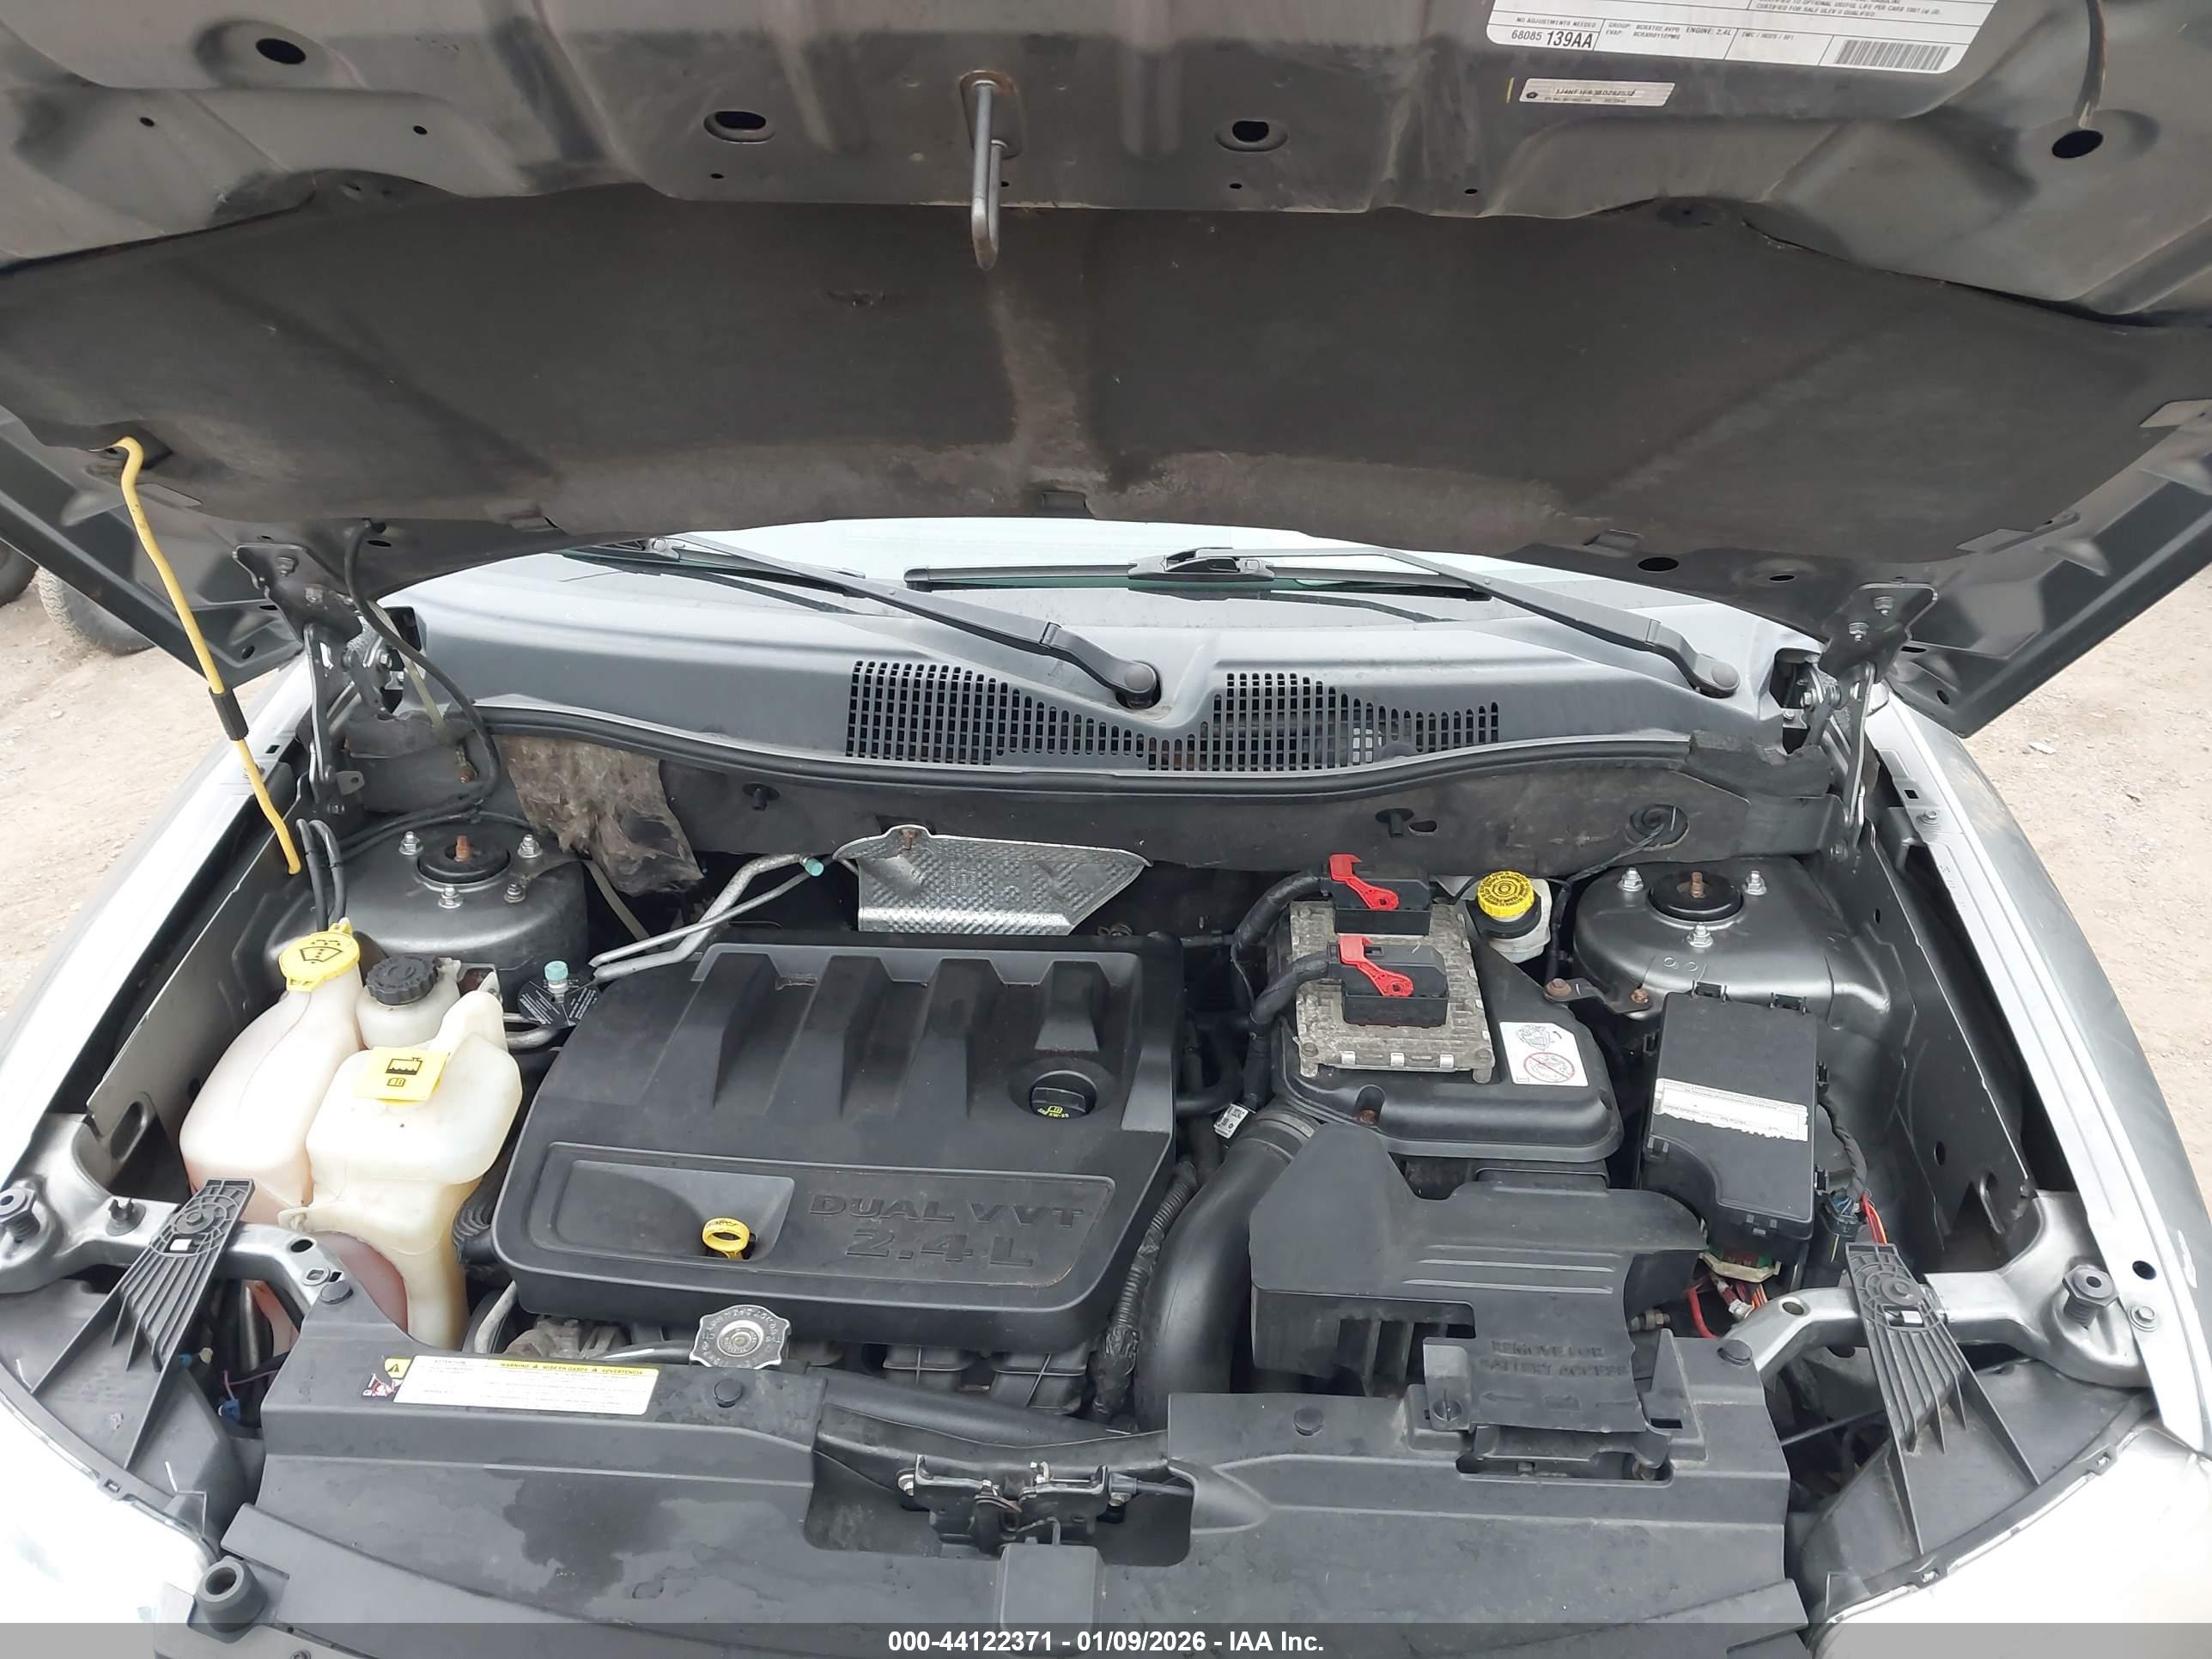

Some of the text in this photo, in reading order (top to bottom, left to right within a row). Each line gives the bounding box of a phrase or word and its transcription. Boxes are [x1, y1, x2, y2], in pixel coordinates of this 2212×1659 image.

[1527, 17, 1571, 26] ADJUSTMENTS
[1510, 29, 1594, 49] 68085 139AA
[810, 1194, 1085, 1229] DUAL VVT
[845, 1229, 1033, 1267] 2.4L
